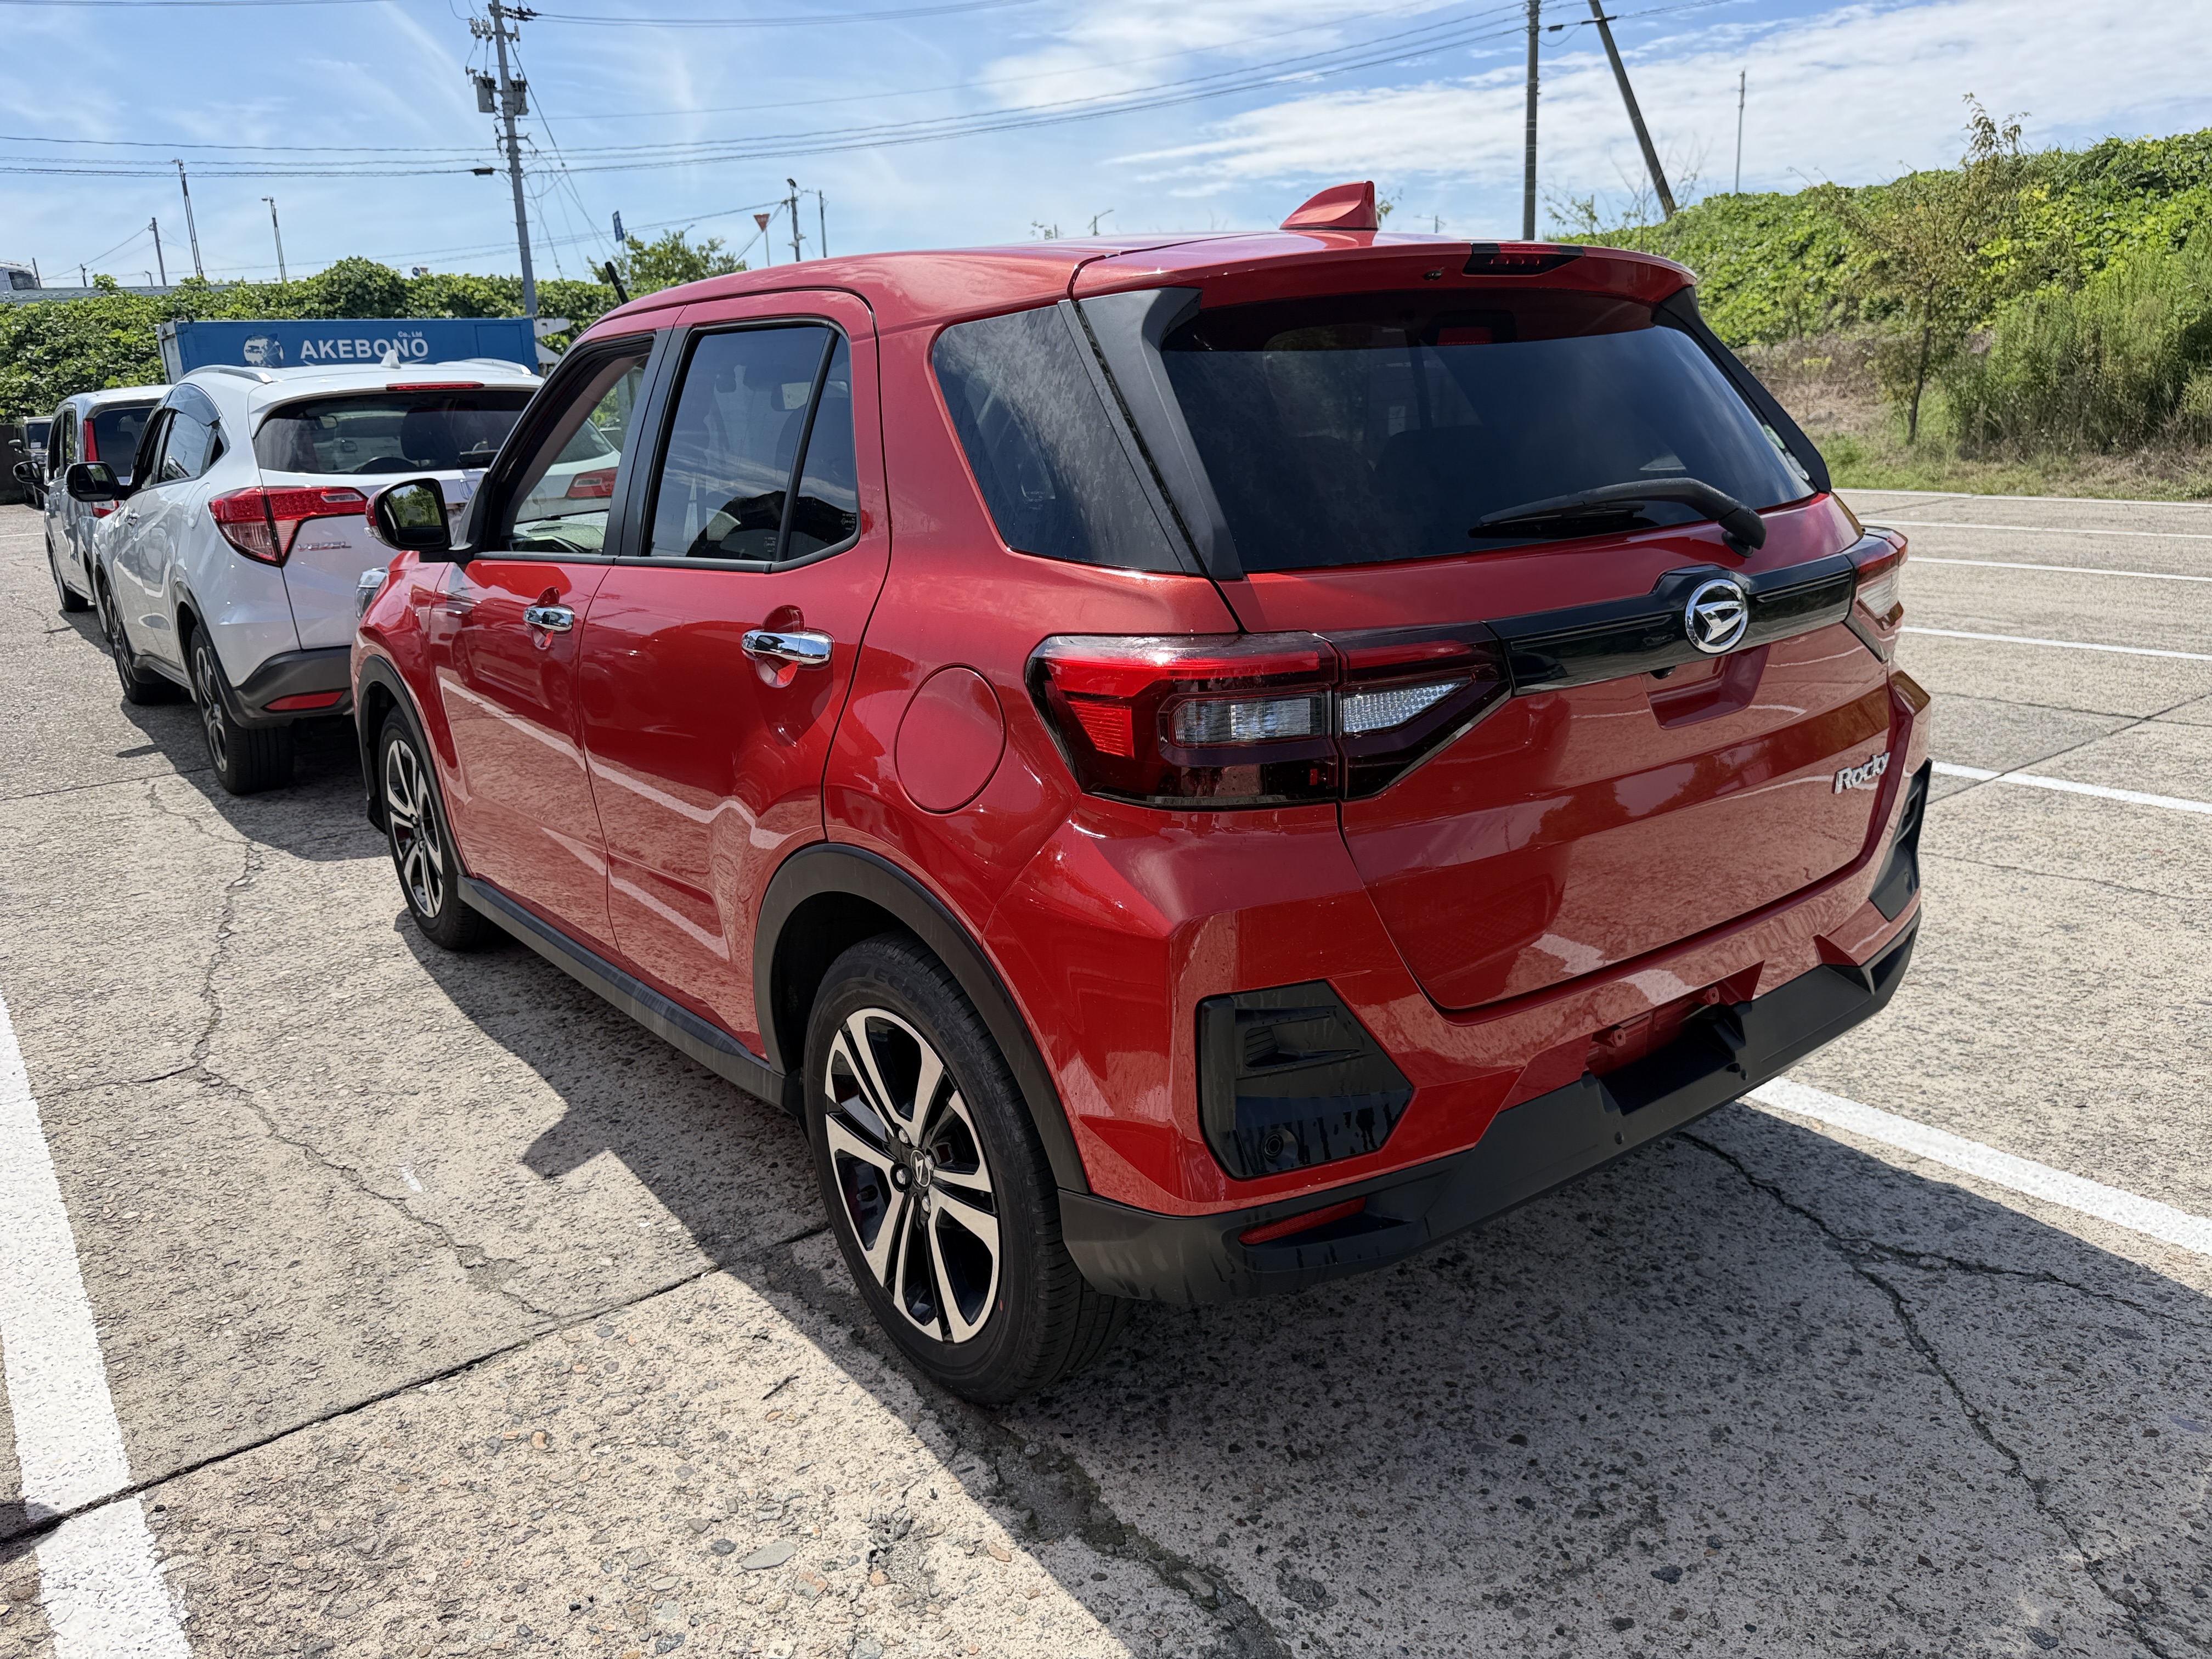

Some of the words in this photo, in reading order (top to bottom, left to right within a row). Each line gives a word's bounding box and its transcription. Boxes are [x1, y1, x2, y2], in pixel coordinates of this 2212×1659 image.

[300, 338, 429, 359] AKEBONO
[297, 541, 352, 552] VEZEL
[1832, 751, 1891, 794] Rocky
